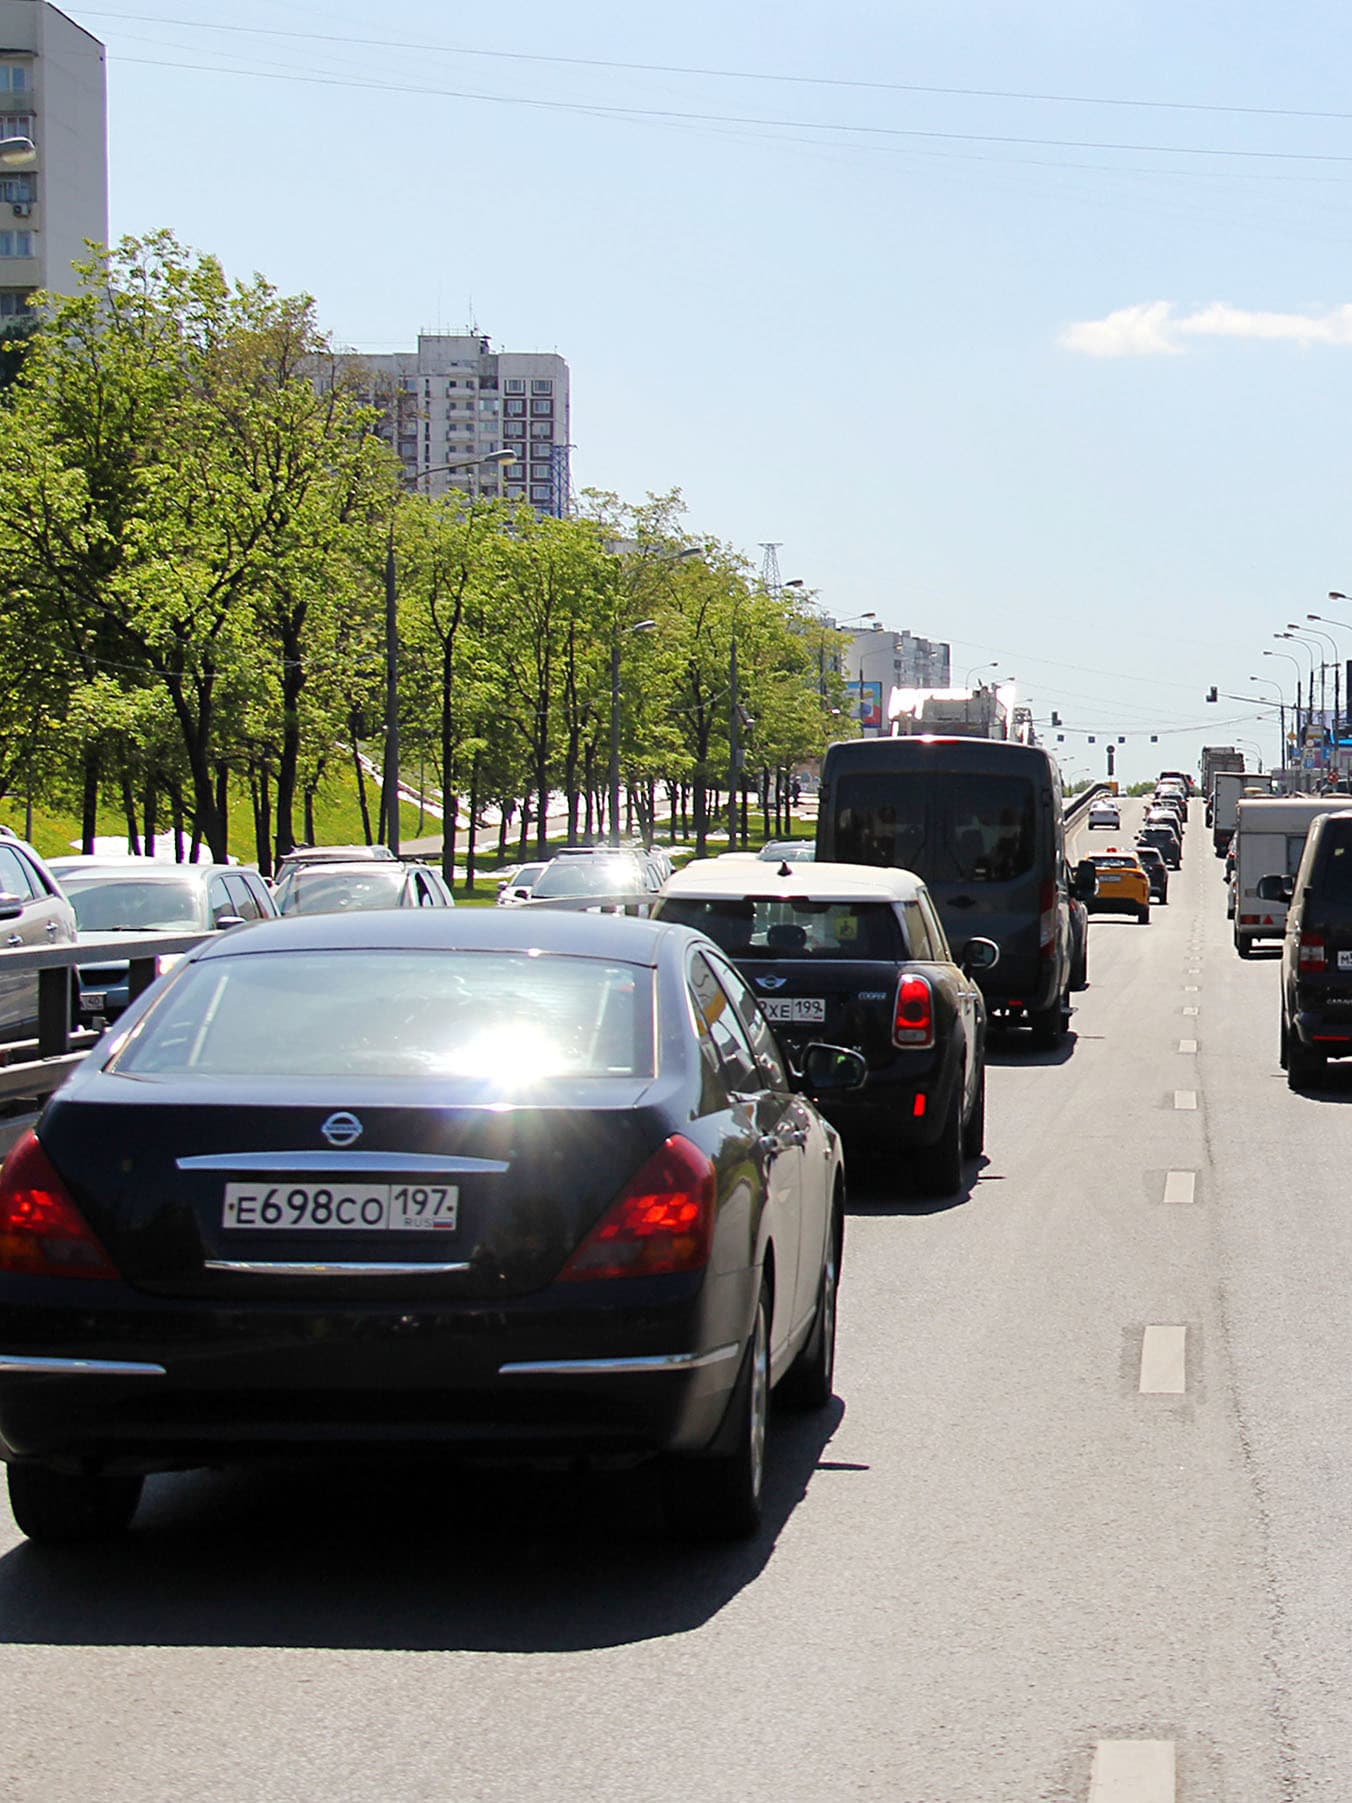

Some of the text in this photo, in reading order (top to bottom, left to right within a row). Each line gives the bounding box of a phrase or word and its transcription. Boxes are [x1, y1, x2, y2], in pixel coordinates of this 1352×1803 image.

[795, 1001, 820, 1014] 199
[236, 1188, 448, 1226] Е698СО 197
[404, 1218, 432, 1228] RUS
